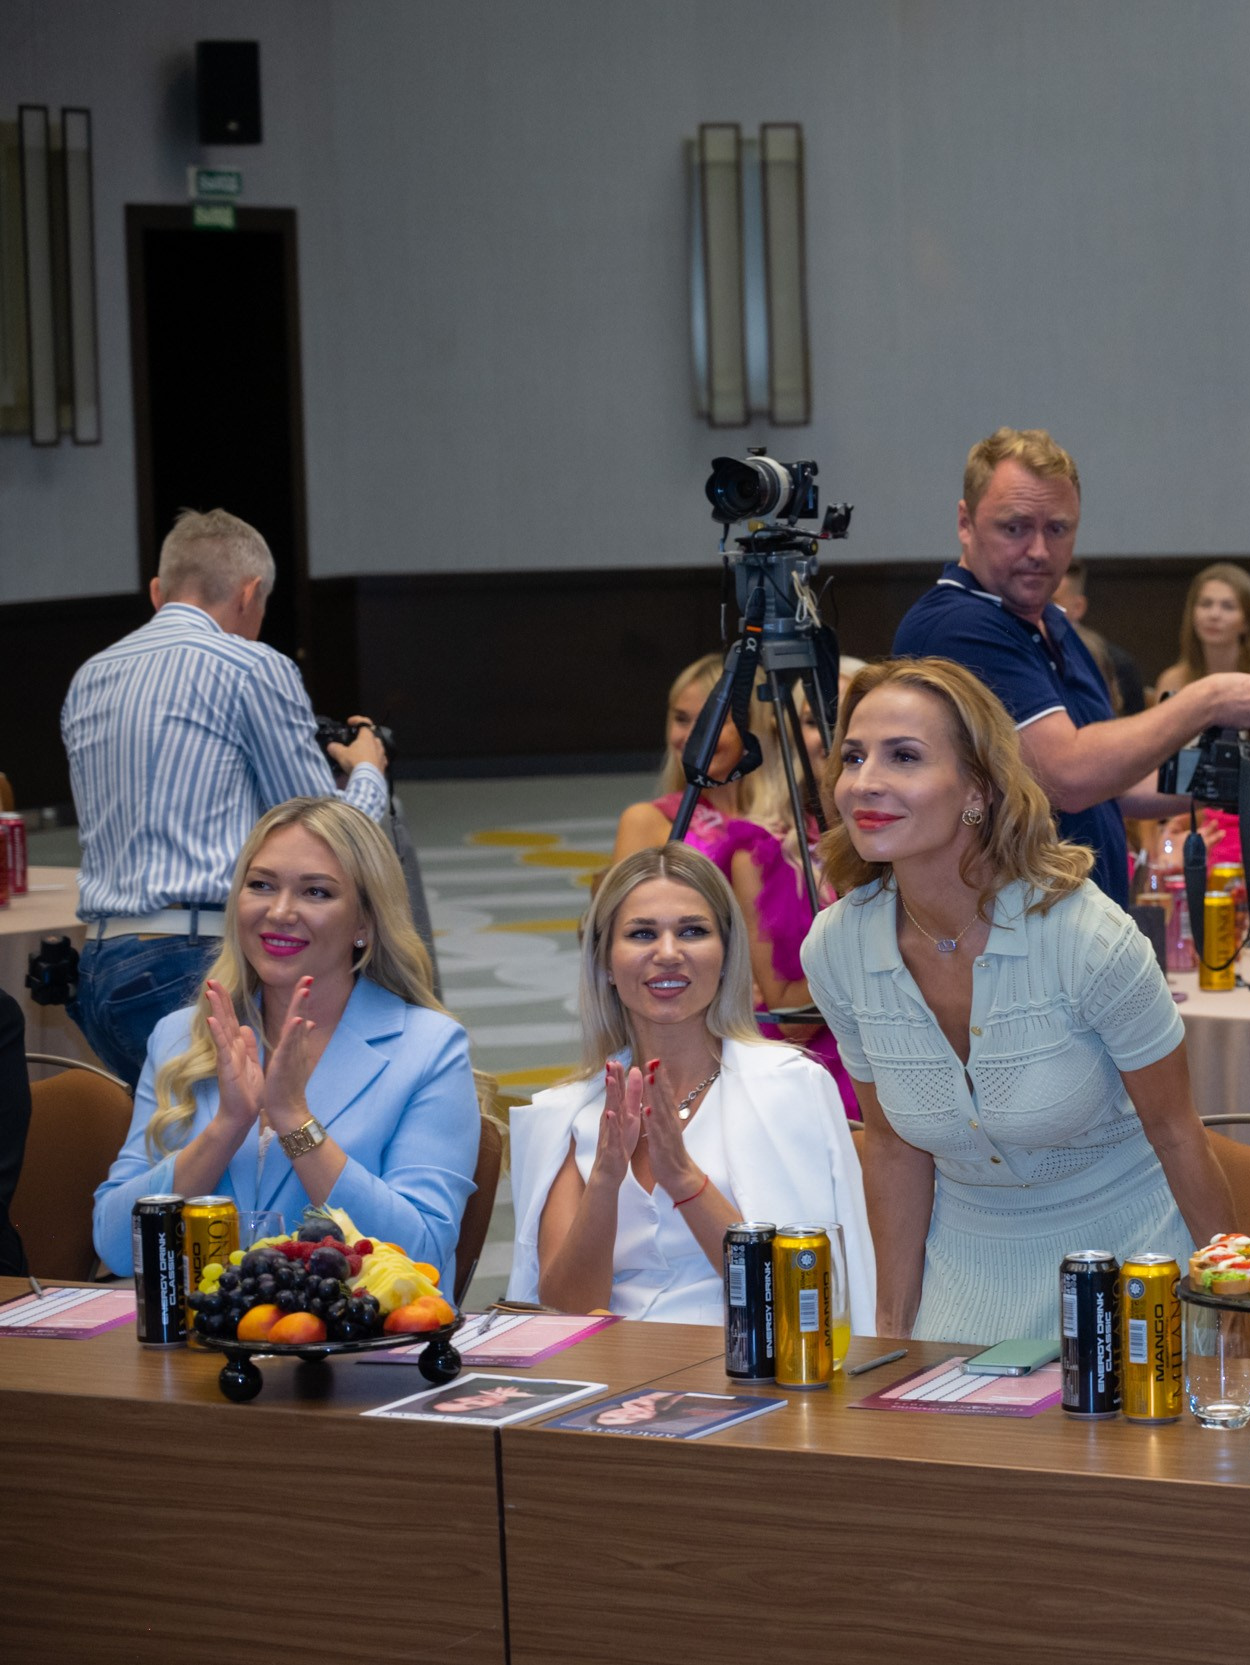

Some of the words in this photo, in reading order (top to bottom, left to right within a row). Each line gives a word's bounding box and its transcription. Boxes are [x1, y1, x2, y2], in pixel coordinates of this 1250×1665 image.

[158, 1232, 167, 1271] DRINK
[167, 1250, 177, 1306] CLASSIC
[159, 1275, 169, 1325] ENERGY
[764, 1261, 772, 1303] DRINK
[765, 1305, 774, 1359] ENERGY
[1096, 1292, 1105, 1335] DRINK
[1097, 1336, 1106, 1393] ENERGY
[1104, 1311, 1112, 1372] CLASSIC
[1154, 1303, 1165, 1383] MANGO
